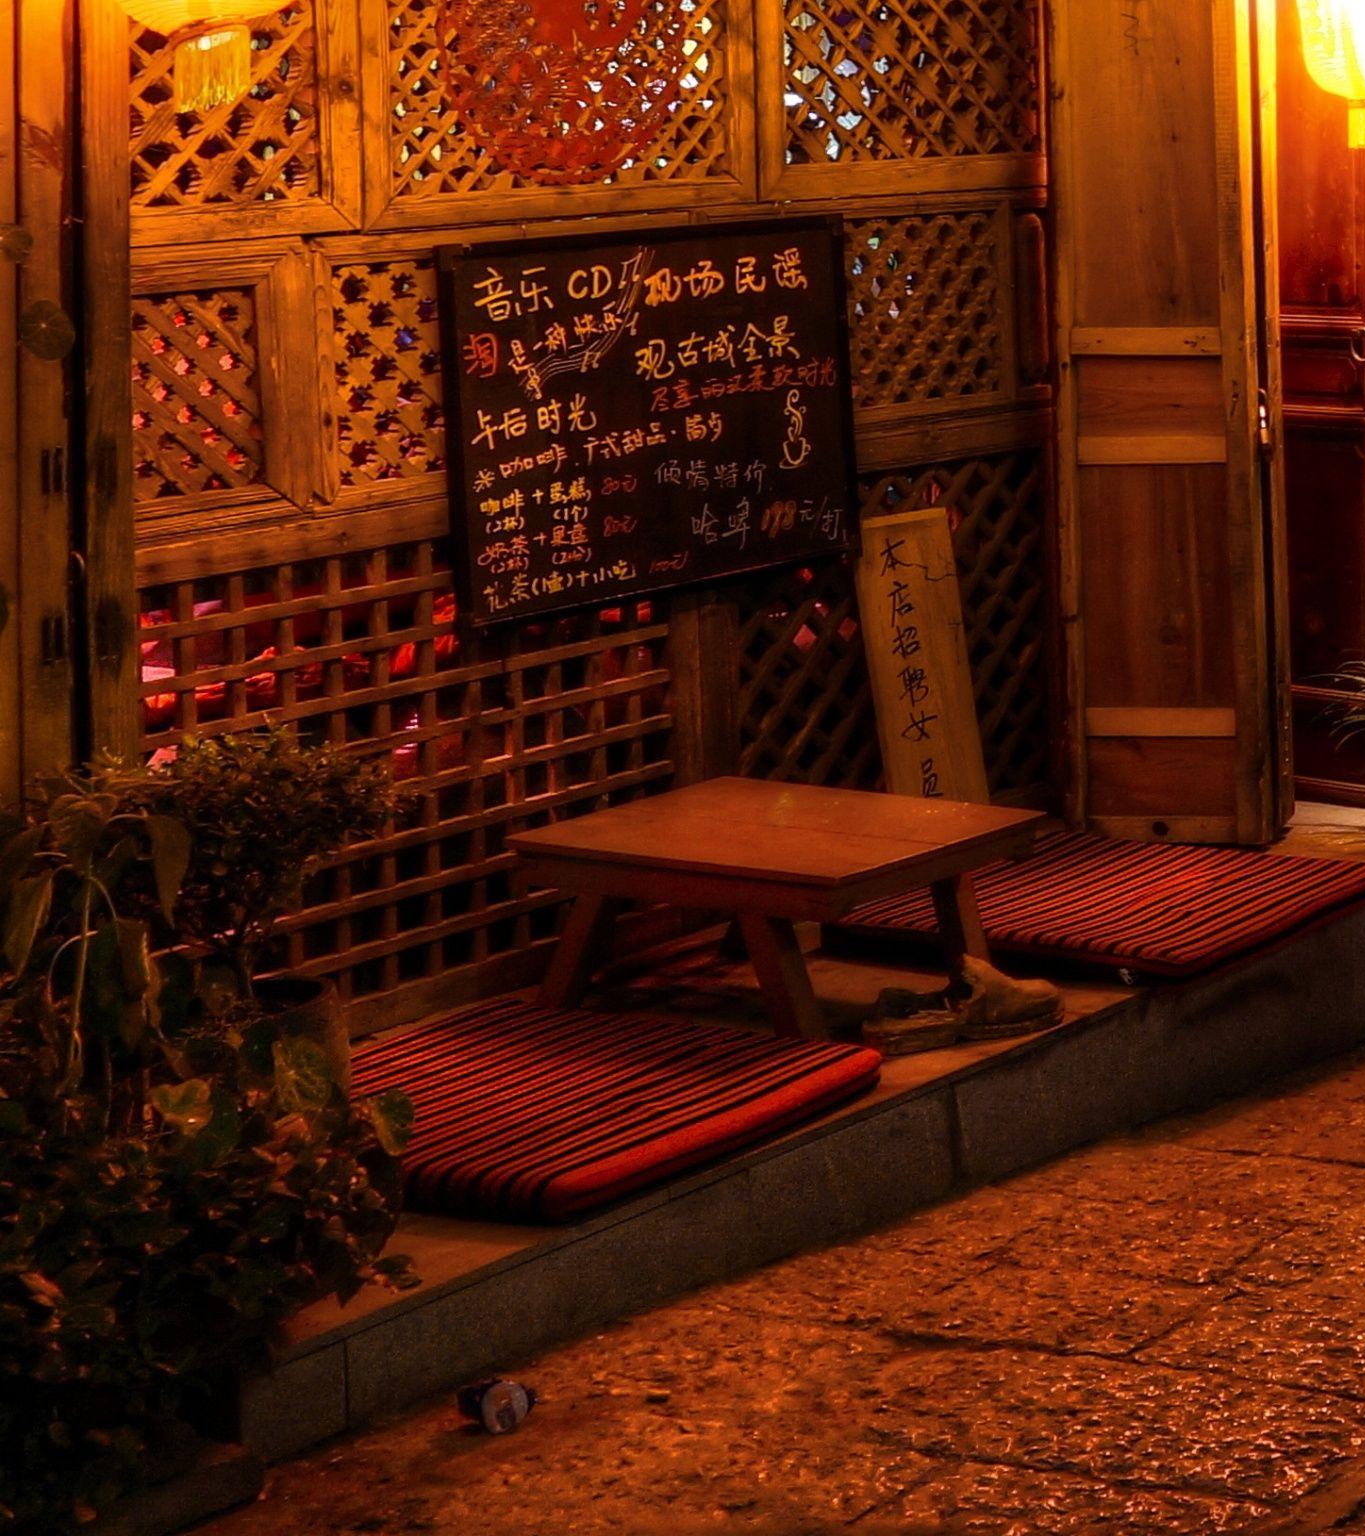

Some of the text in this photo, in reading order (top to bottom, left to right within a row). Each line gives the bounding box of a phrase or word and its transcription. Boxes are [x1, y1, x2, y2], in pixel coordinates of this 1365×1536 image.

[635, 316, 800, 381] 观古城全景
[471, 393, 598, 450] 午后时光
